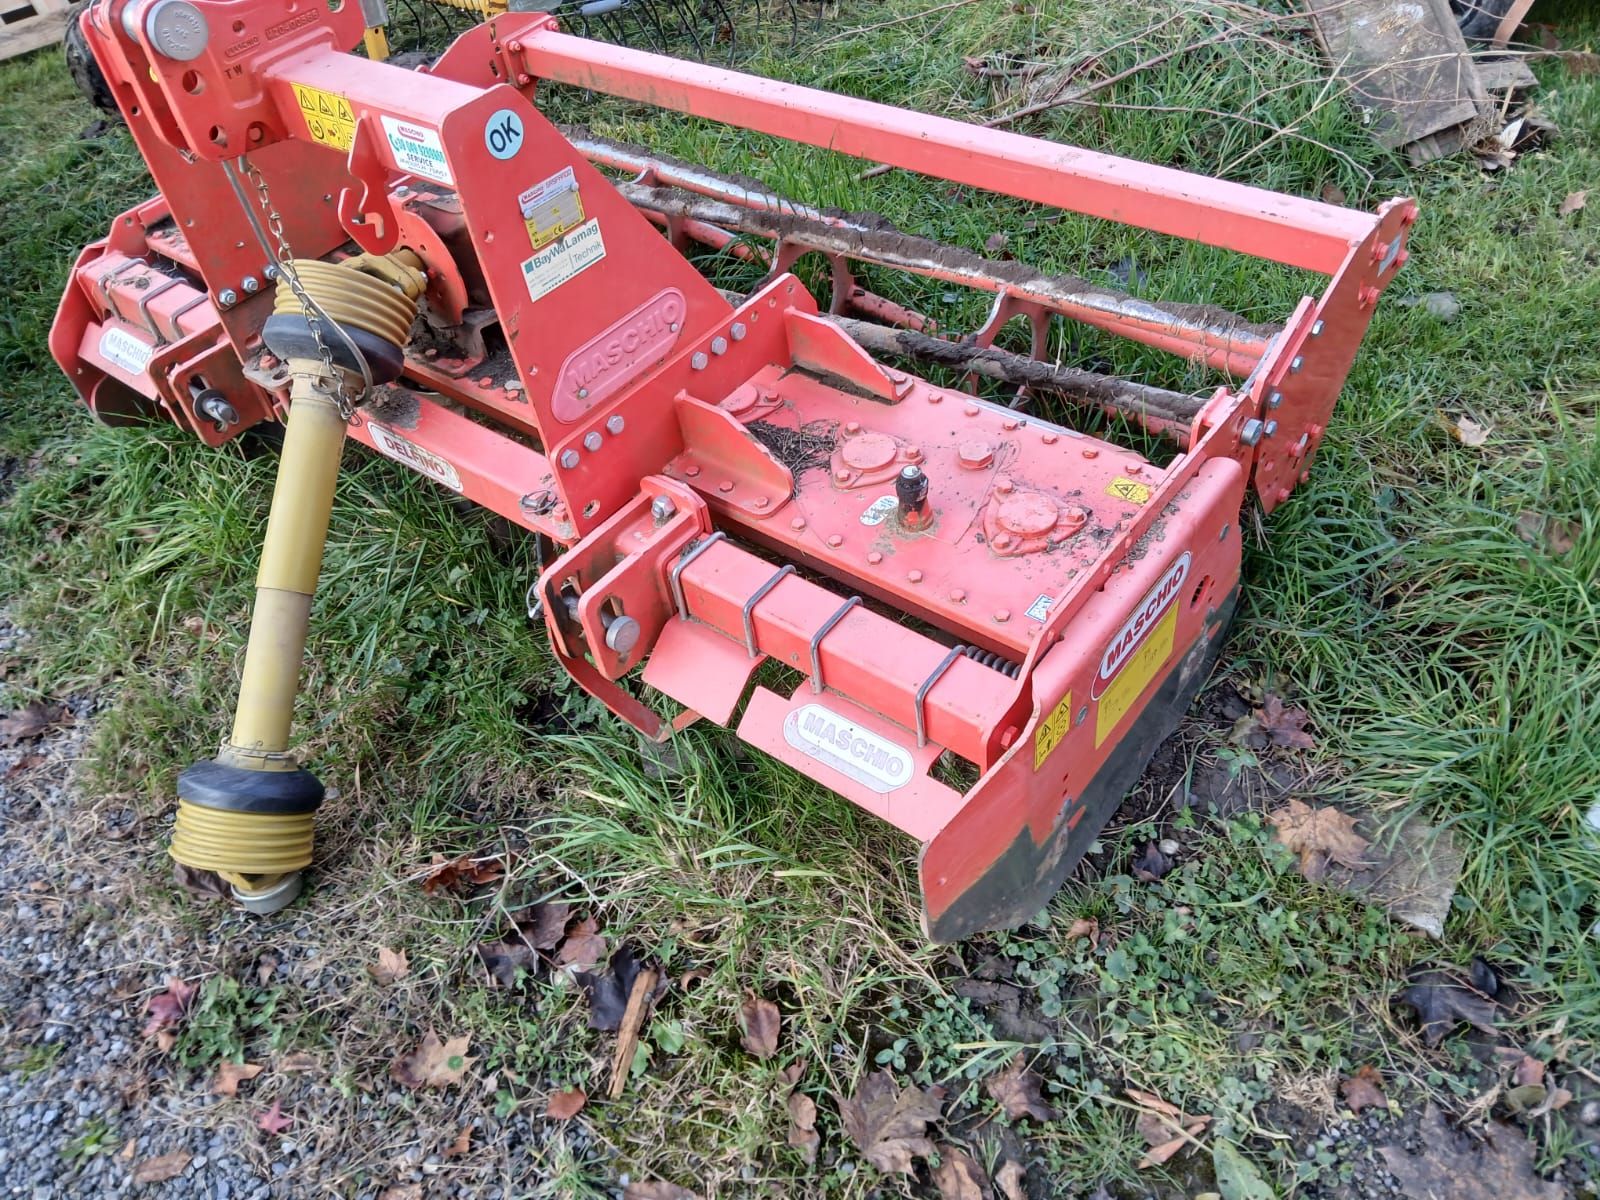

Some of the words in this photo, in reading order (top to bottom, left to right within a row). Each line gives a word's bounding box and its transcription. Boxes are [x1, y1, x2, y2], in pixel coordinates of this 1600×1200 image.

[399, 126, 424, 138] MASCHIO
[490, 116, 520, 152] OK
[406, 153, 433, 167] SERVICE
[523, 186, 544, 200] MASCHIO
[573, 241, 602, 263] Technik
[108, 333, 150, 364] MASCHIO
[566, 300, 680, 396] MASCHIO
[383, 436, 445, 476] DELFINO
[1105, 564, 1184, 672] MASCHIO
[802, 711, 904, 778] MASCHIO
